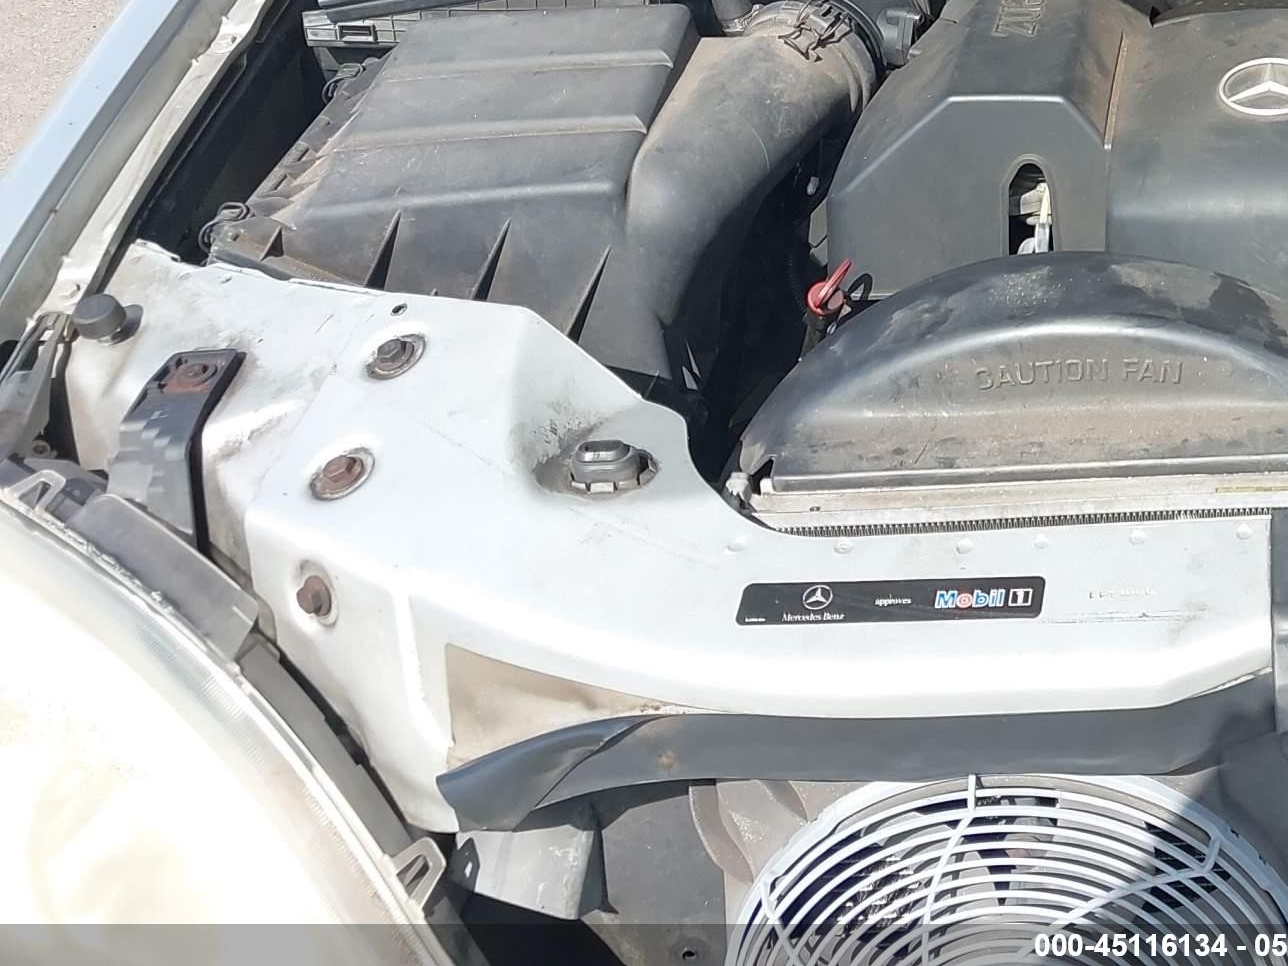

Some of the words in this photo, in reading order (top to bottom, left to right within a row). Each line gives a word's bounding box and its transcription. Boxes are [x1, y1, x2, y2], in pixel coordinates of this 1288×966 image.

[975, 358, 1109, 390] CAUTION
[1121, 358, 1184, 385] FAN
[874, 593, 912, 607] approves
[934, 588, 1006, 609] Mobil
